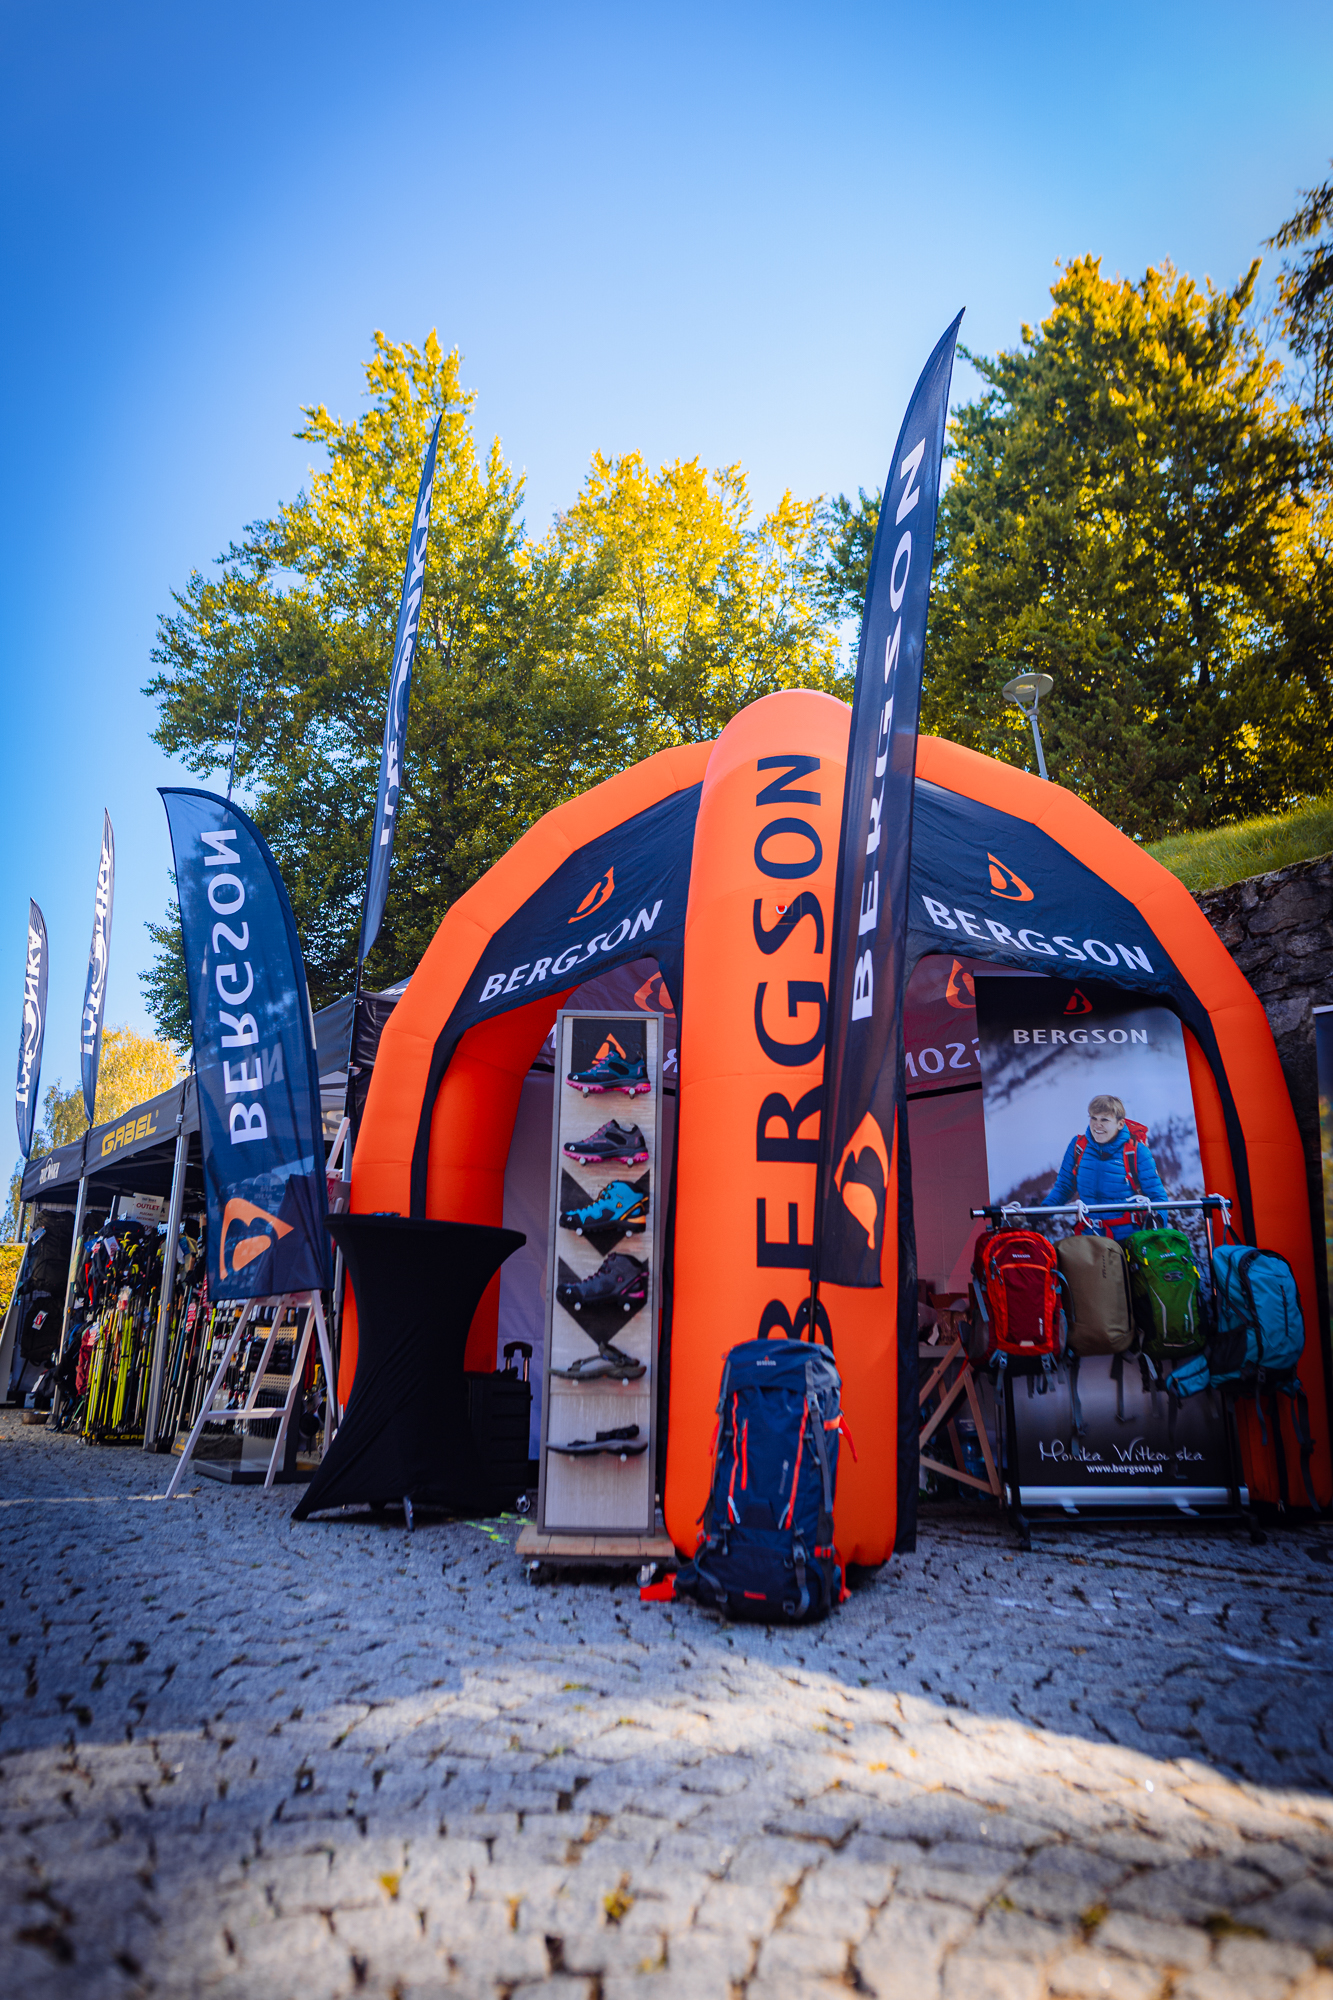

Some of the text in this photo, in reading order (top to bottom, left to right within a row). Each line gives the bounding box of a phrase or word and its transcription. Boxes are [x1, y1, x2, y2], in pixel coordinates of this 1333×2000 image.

[851, 437, 926, 1021] BERGSON
[478, 899, 664, 1004] BERGSON
[921, 895, 1154, 974] BERGSON
[753, 754, 833, 1343] BERGSON
[1013, 1028, 1149, 1045] BERGSON
[101, 1112, 158, 1157] GABEL
[1086, 1463, 1163, 1476] www.bergson.pl
